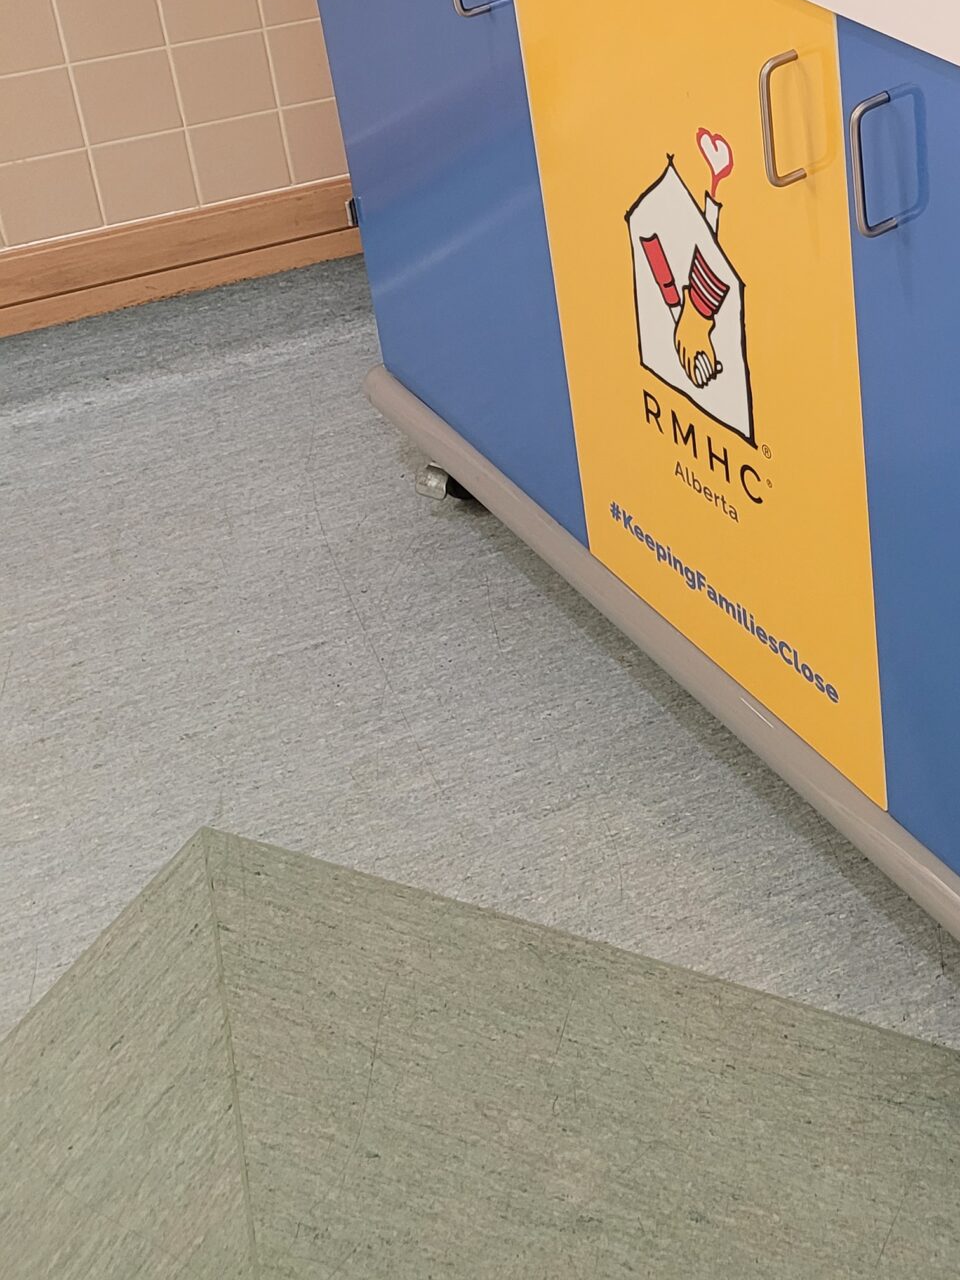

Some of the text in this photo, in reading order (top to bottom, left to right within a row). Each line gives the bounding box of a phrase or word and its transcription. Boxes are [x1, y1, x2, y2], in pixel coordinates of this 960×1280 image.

[643, 389, 764, 505] RMHC
[674, 460, 740, 524] Alberta
[610, 500, 840, 704] #KeepingFamiliesClose
